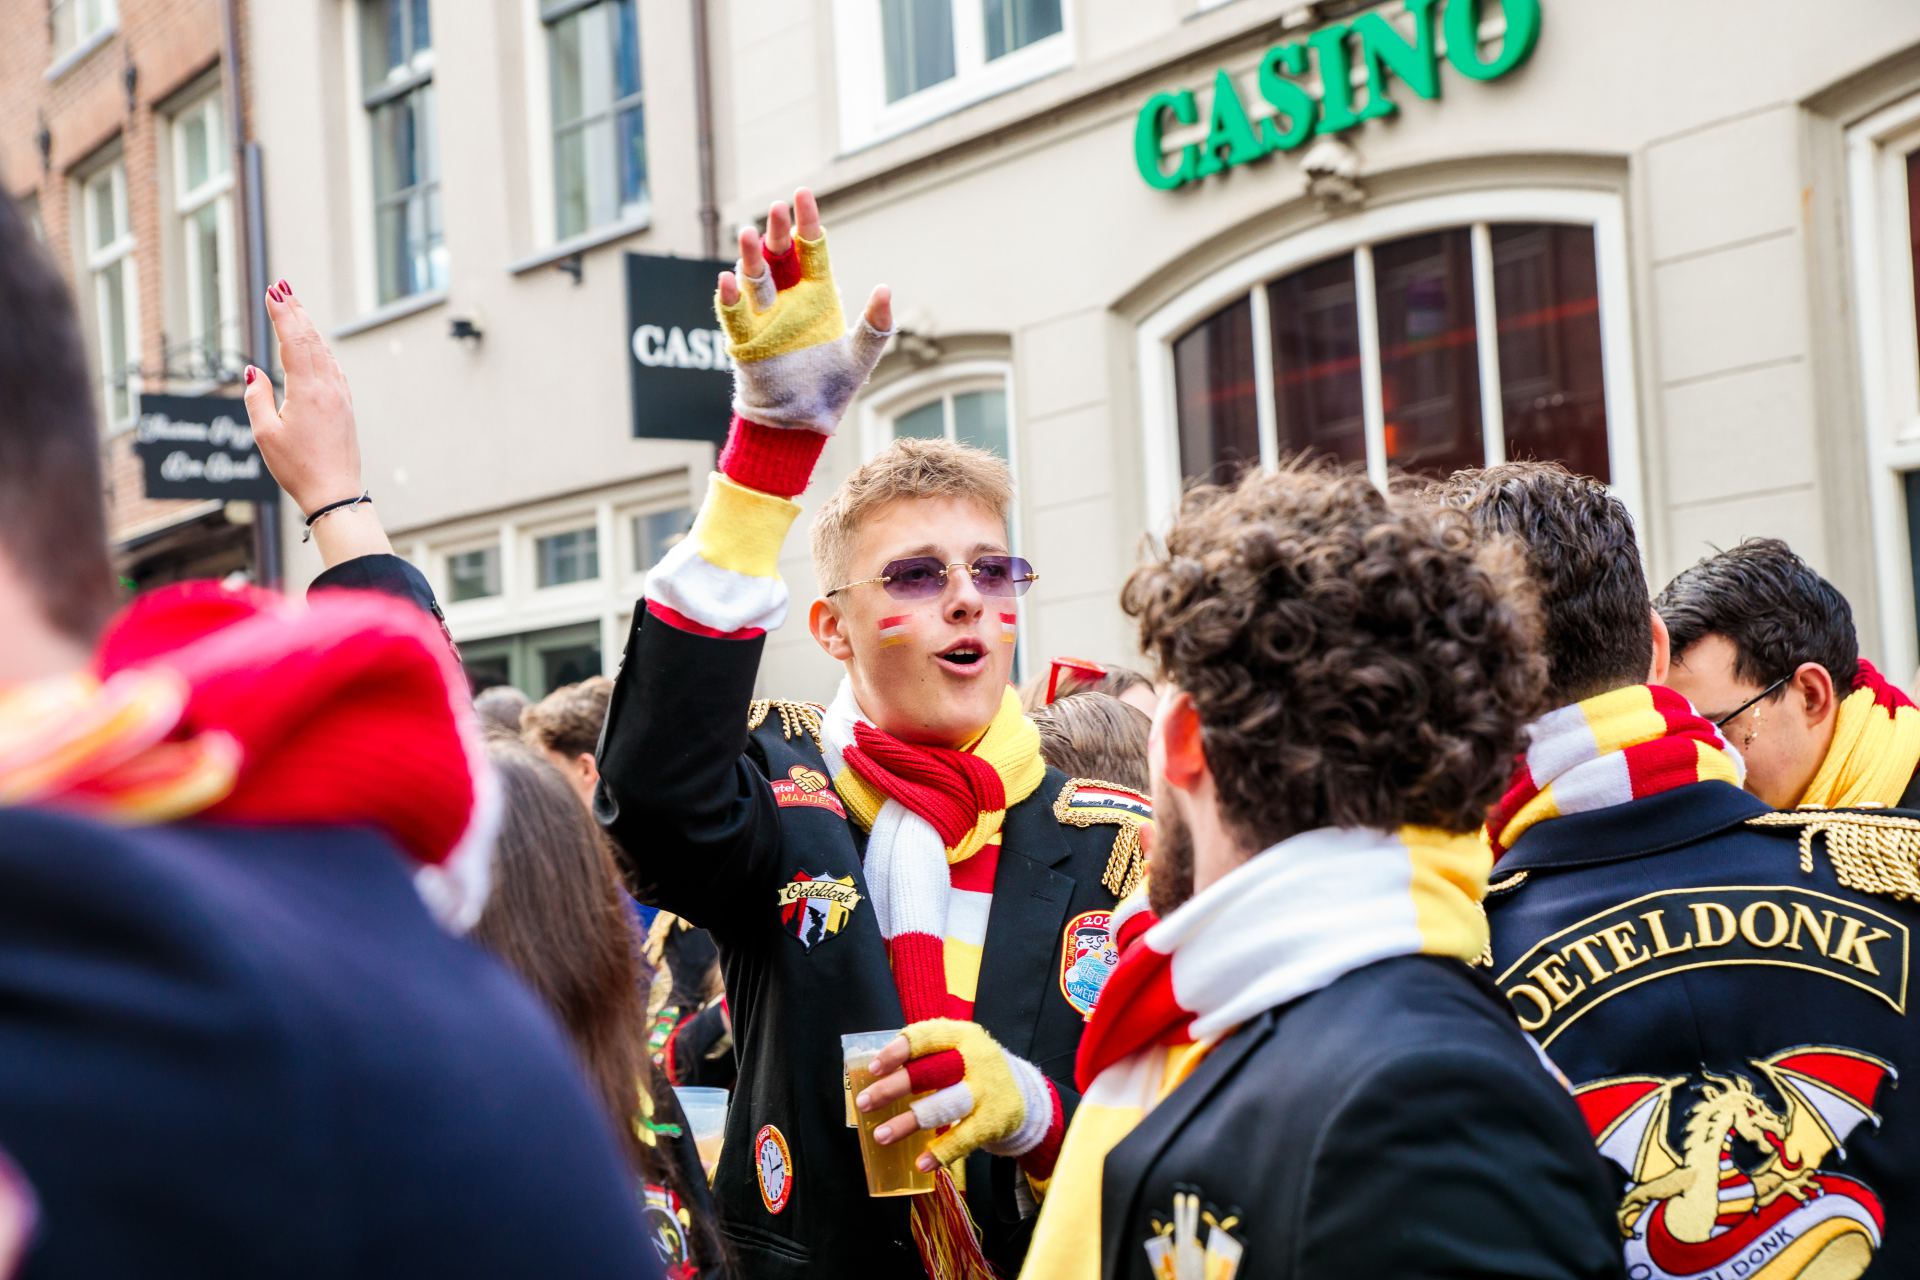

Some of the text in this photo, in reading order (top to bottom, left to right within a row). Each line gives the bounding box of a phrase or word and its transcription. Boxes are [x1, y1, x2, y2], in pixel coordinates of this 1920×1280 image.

[1134, 0, 1541, 190] CASINO
[632, 324, 735, 372] CASI
[773, 784, 795, 793] etel
[786, 882, 855, 903] Oeteldonk
[1083, 915, 1112, 928] 202
[1506, 901, 1891, 1031] OETELDONK
